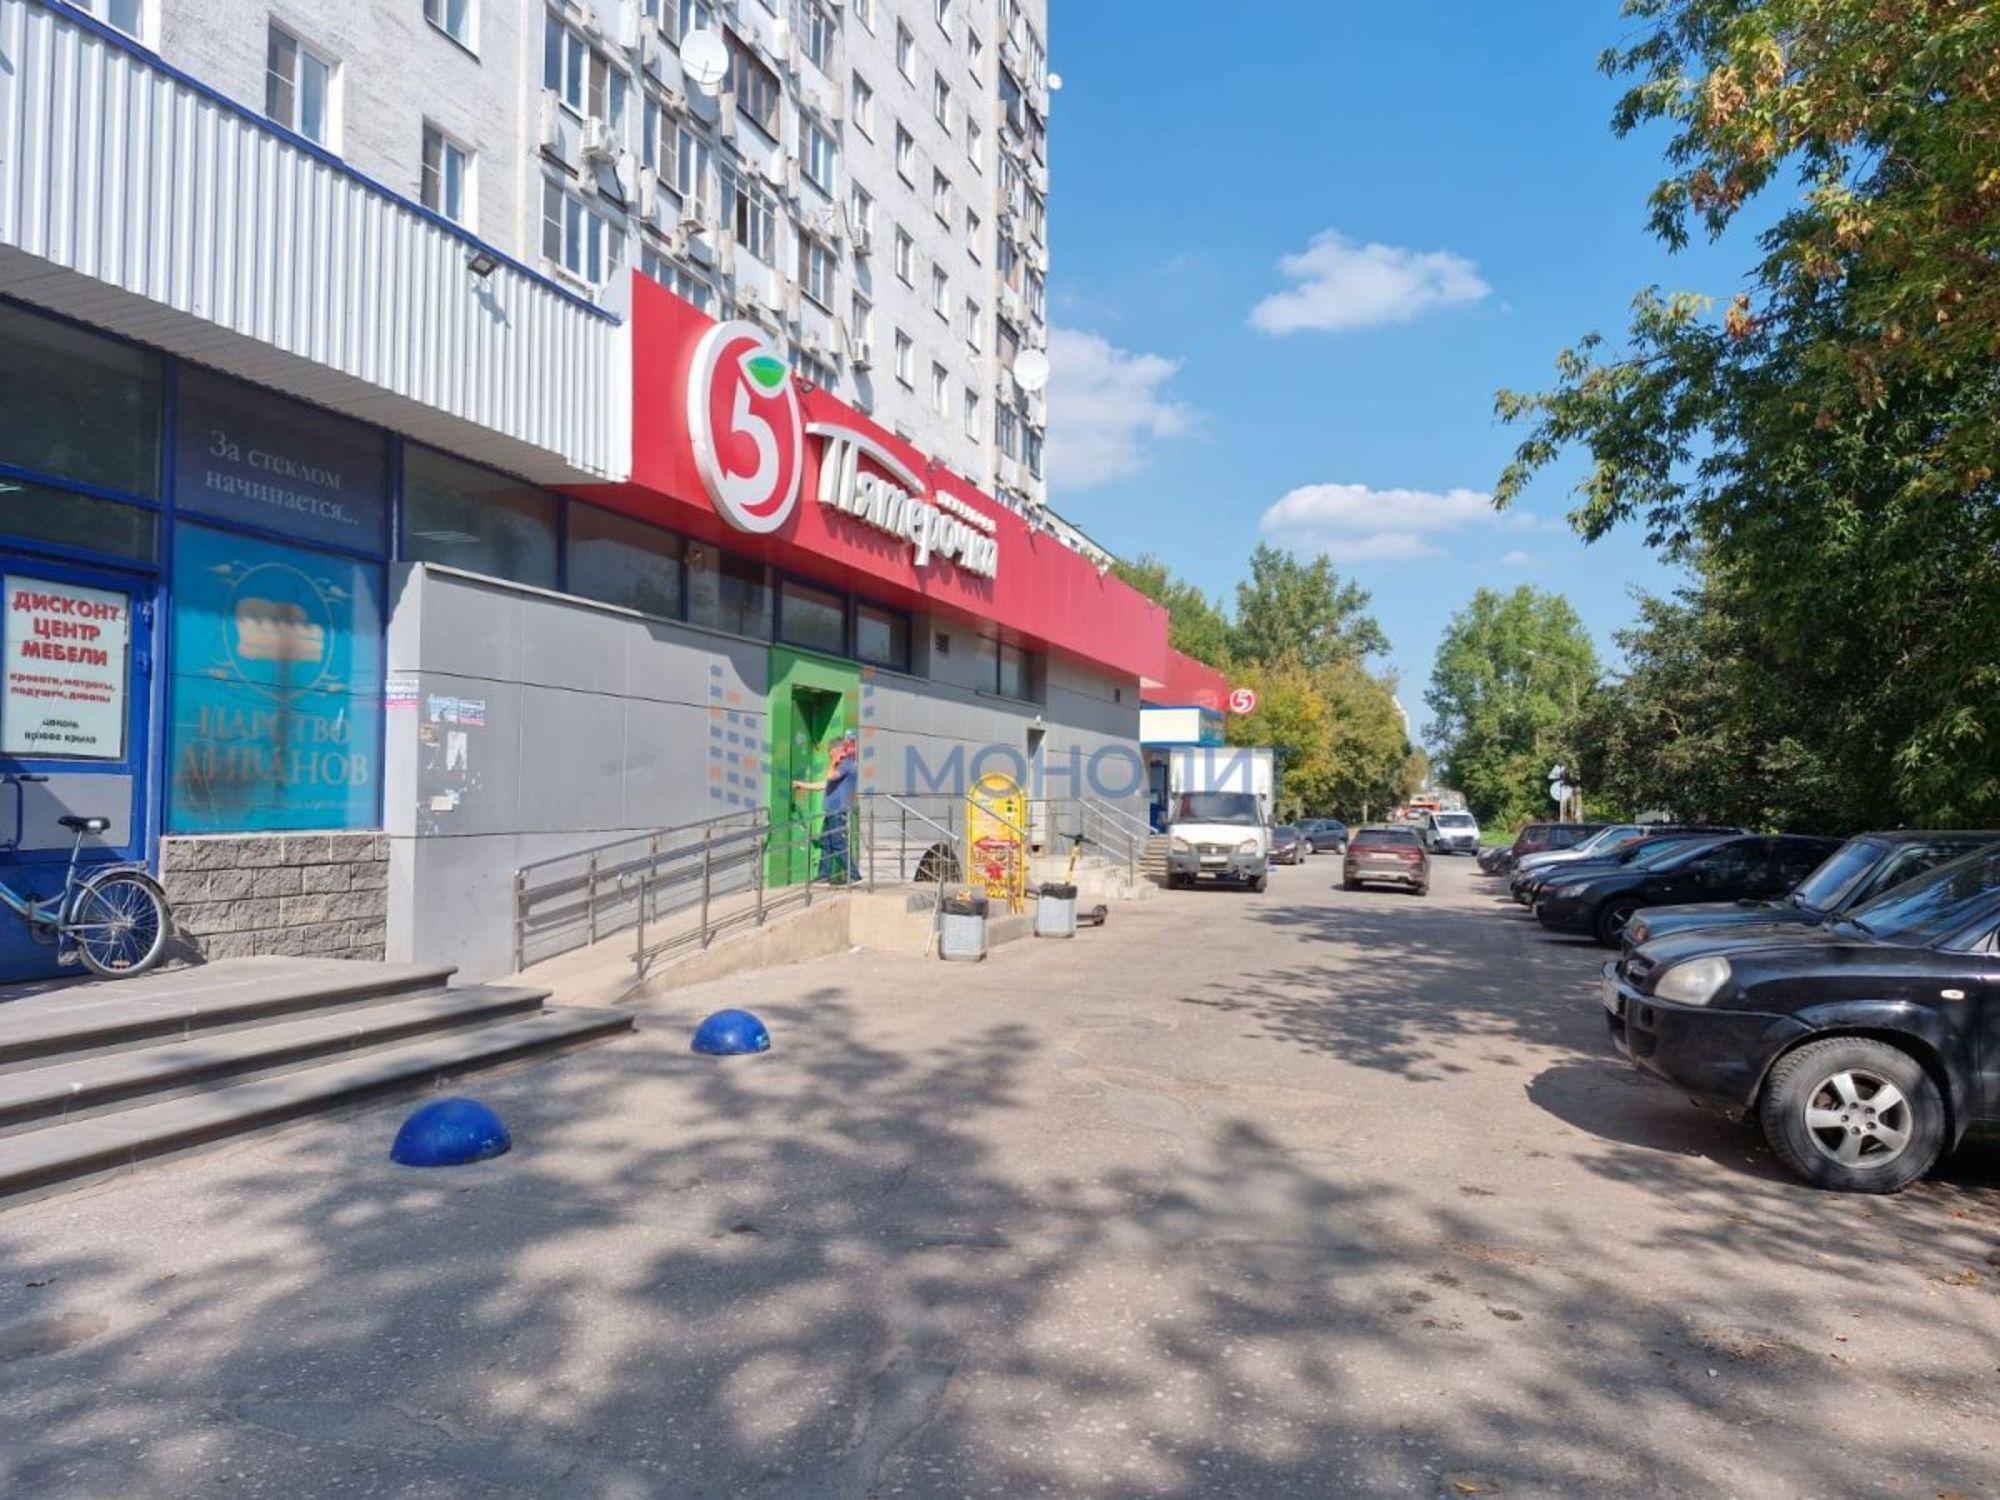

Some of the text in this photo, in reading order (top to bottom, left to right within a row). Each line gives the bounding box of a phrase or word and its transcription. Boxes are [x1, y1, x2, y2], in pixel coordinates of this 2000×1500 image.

[702, 350, 792, 508] 5
[209, 429, 342, 490] За стеклом
[805, 422, 998, 580] Пятерочка
[12, 591, 121, 621] ДИСКОНТ
[33, 617, 101, 641] ЦЕНТР
[21, 640, 108, 666] МЕБЕЛИ
